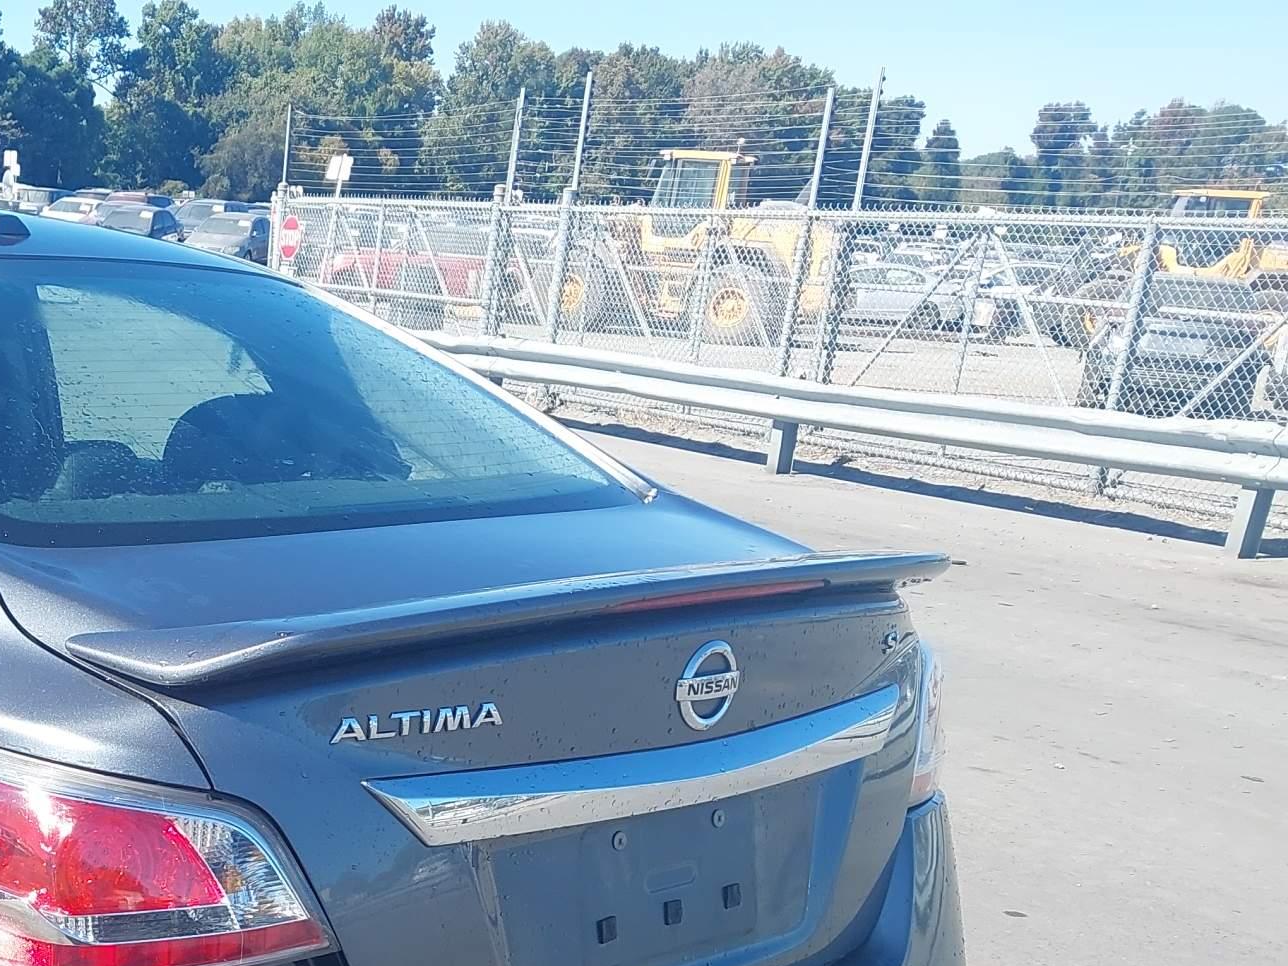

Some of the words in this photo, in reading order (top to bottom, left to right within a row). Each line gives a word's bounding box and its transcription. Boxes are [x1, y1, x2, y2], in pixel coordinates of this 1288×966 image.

[280, 229, 301, 247] STOP
[687, 677, 738, 697] NISSAN
[329, 701, 504, 745] ALTIMA
